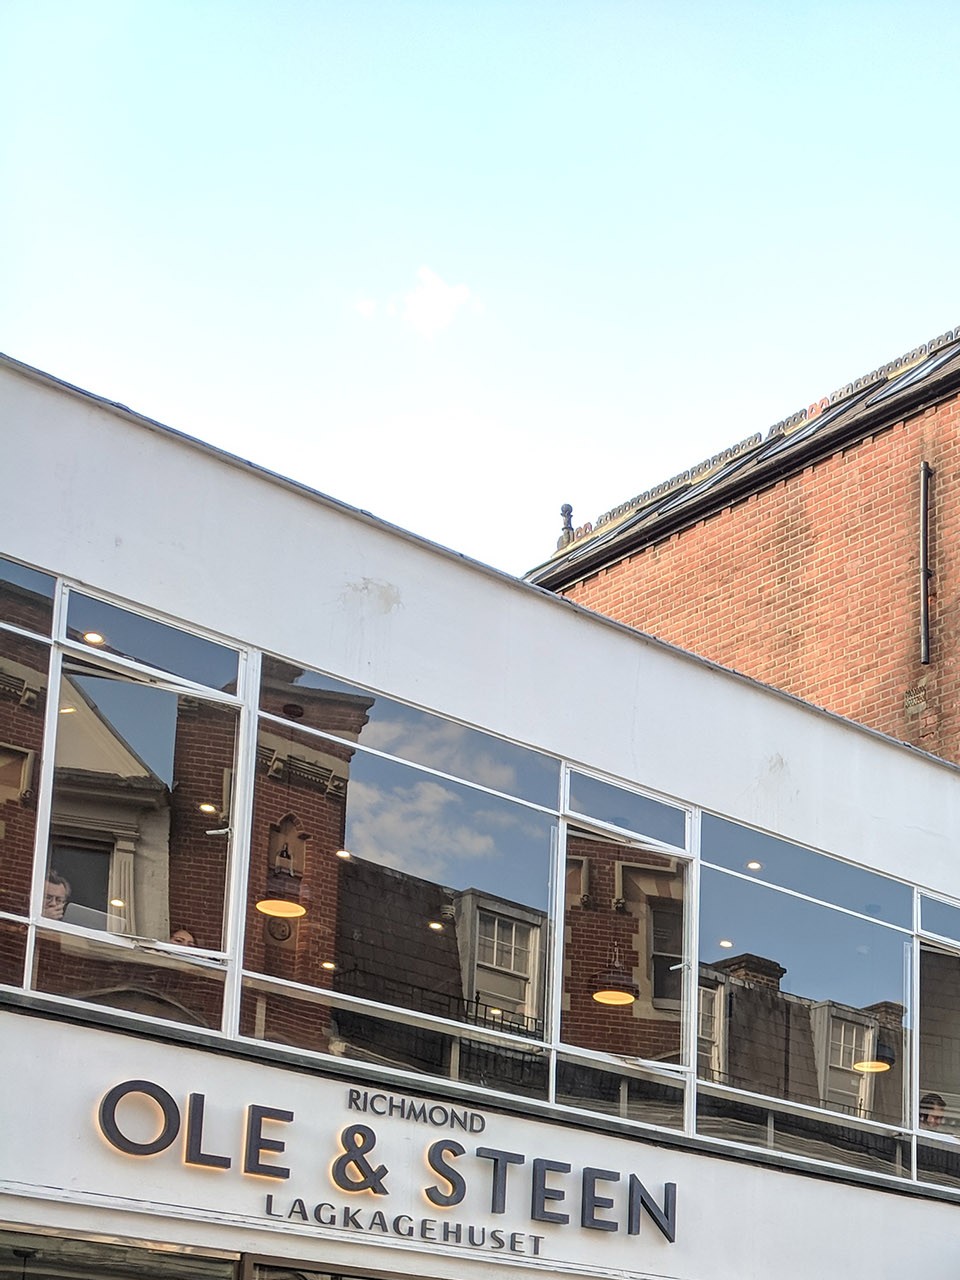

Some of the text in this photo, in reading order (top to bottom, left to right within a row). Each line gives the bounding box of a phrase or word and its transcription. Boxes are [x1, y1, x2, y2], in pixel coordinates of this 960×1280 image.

[348, 1088, 486, 1133] RICHMOND
[98, 1079, 677, 1244] OLE & STEEN
[264, 1193, 545, 1256] LAGKAGEHUSET
